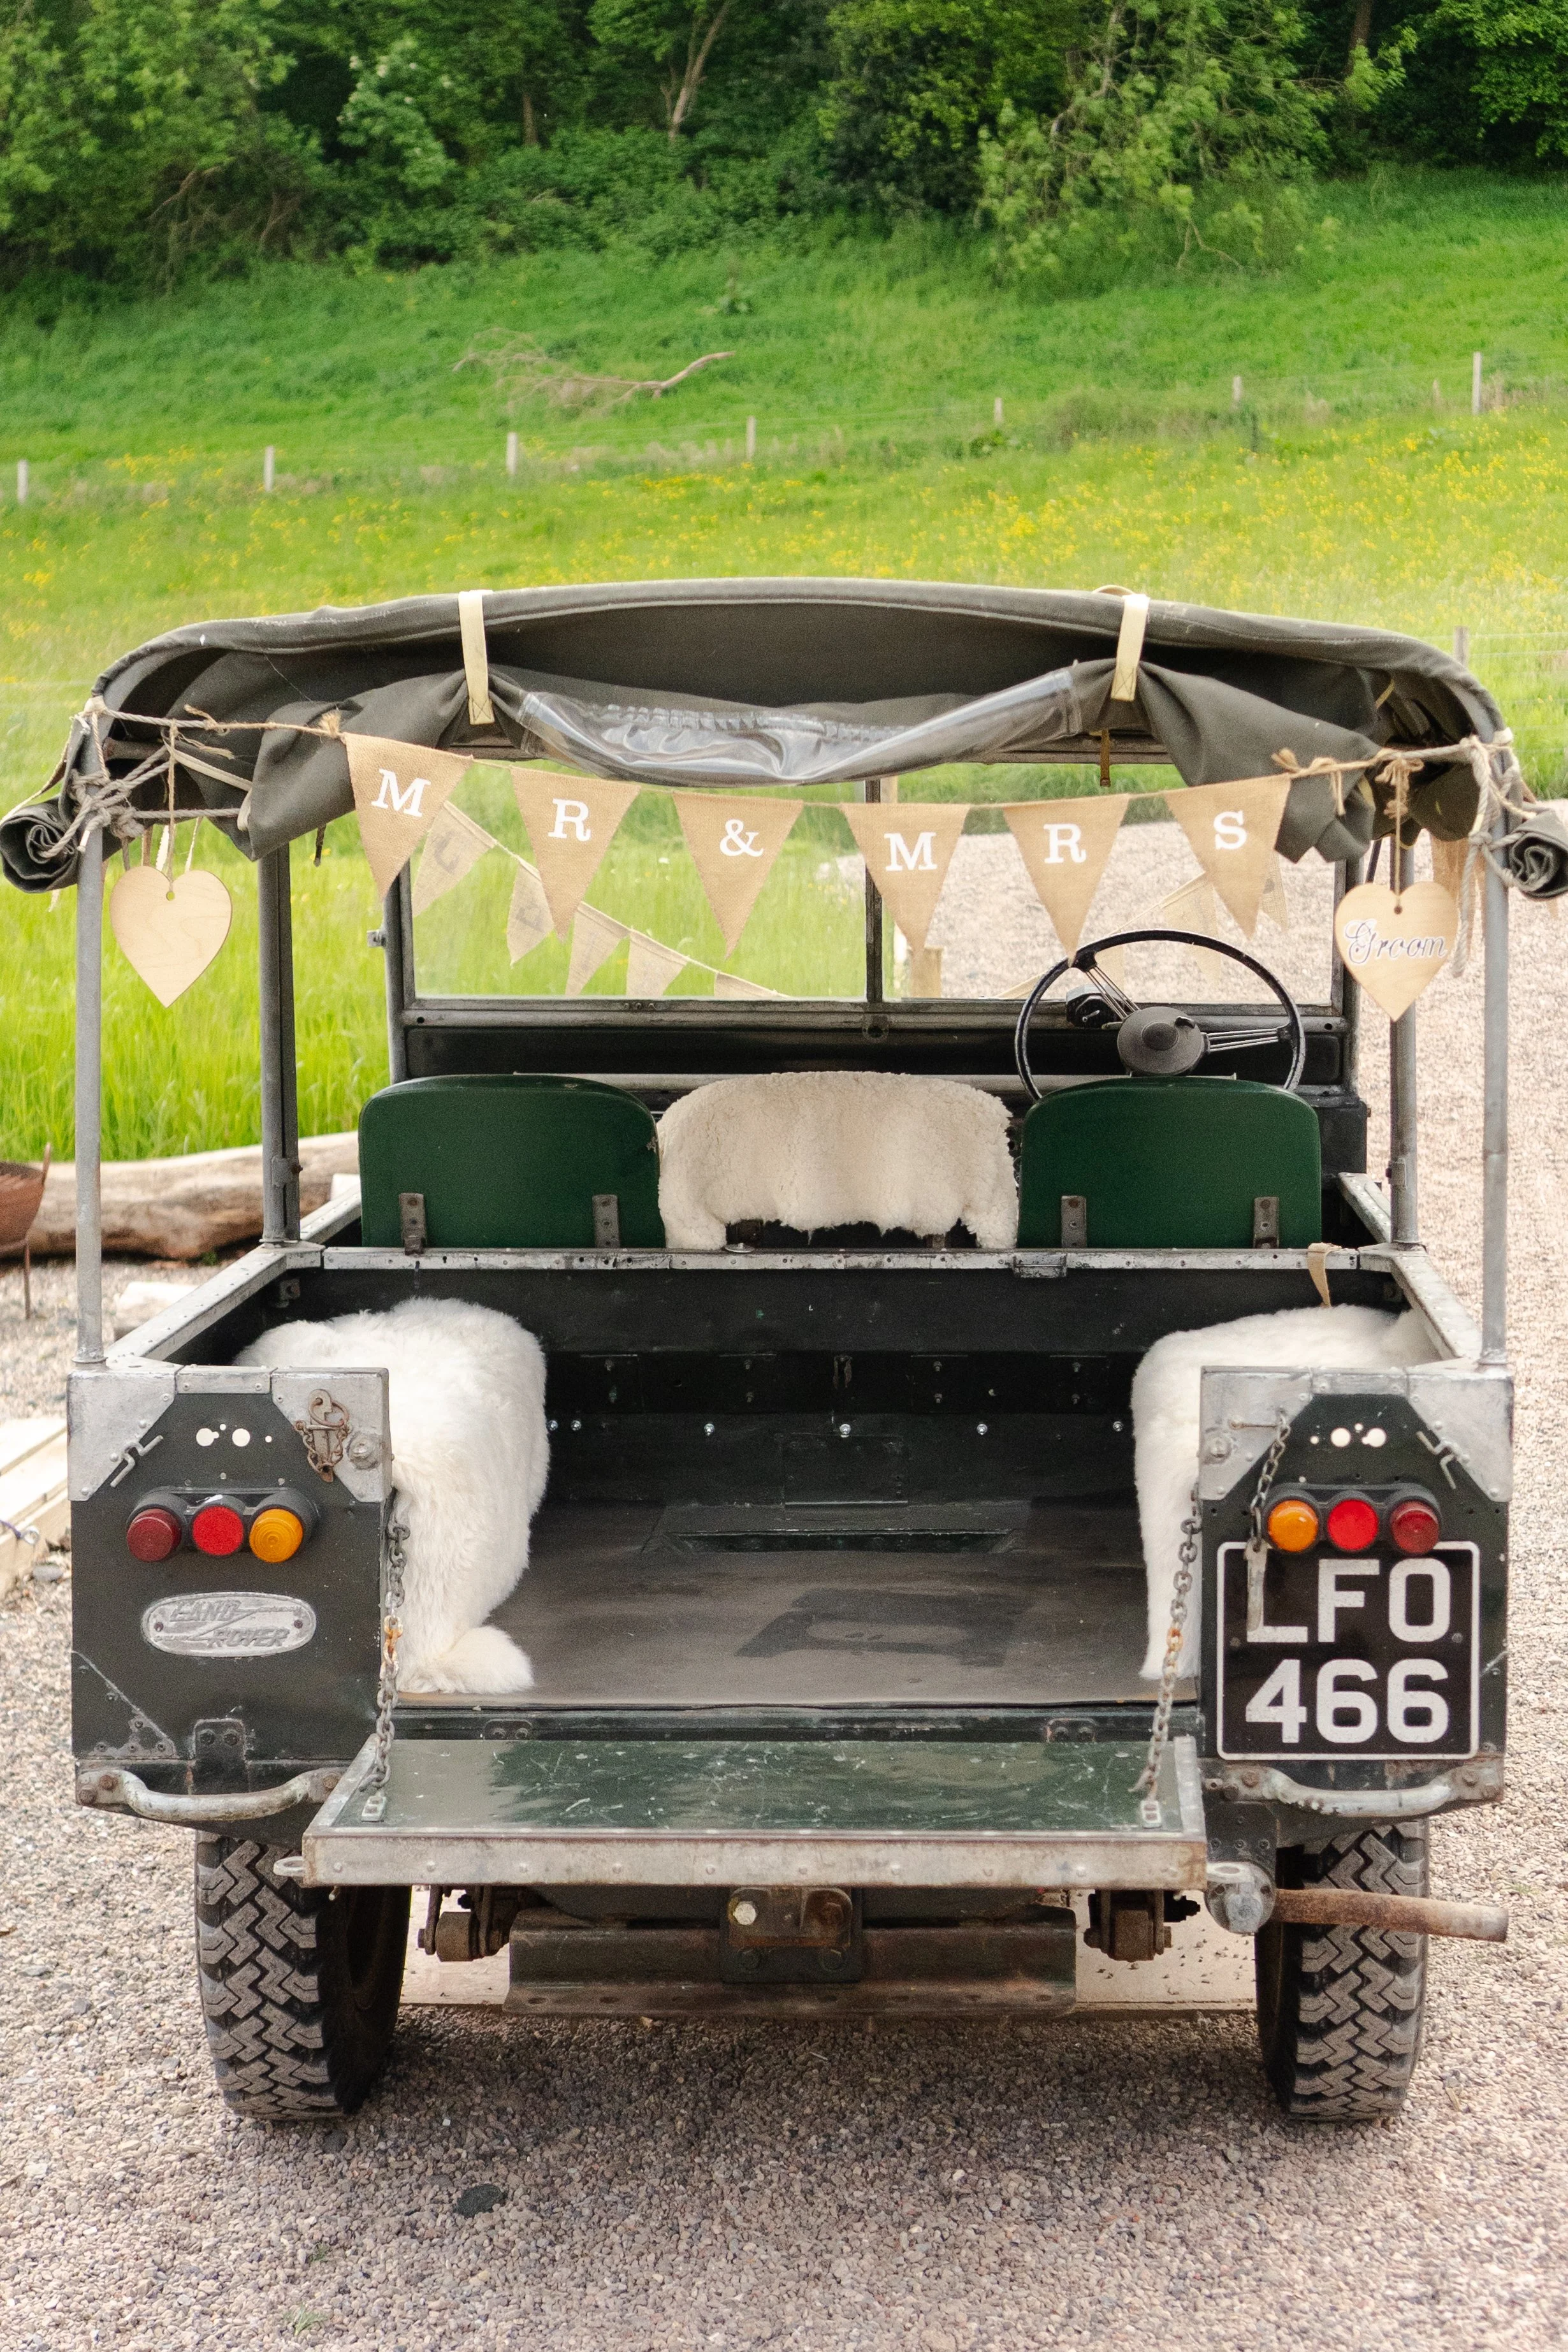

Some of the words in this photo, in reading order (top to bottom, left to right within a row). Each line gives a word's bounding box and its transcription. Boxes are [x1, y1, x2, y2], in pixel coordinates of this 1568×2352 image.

[719, 818, 764, 857] &
[1343, 918, 1448, 966] Groom
[168, 1599, 242, 1622] LAND
[1247, 1558, 1451, 1643] LFO
[207, 1627, 291, 1648] ROVER
[1245, 1659, 1450, 1743] 466
